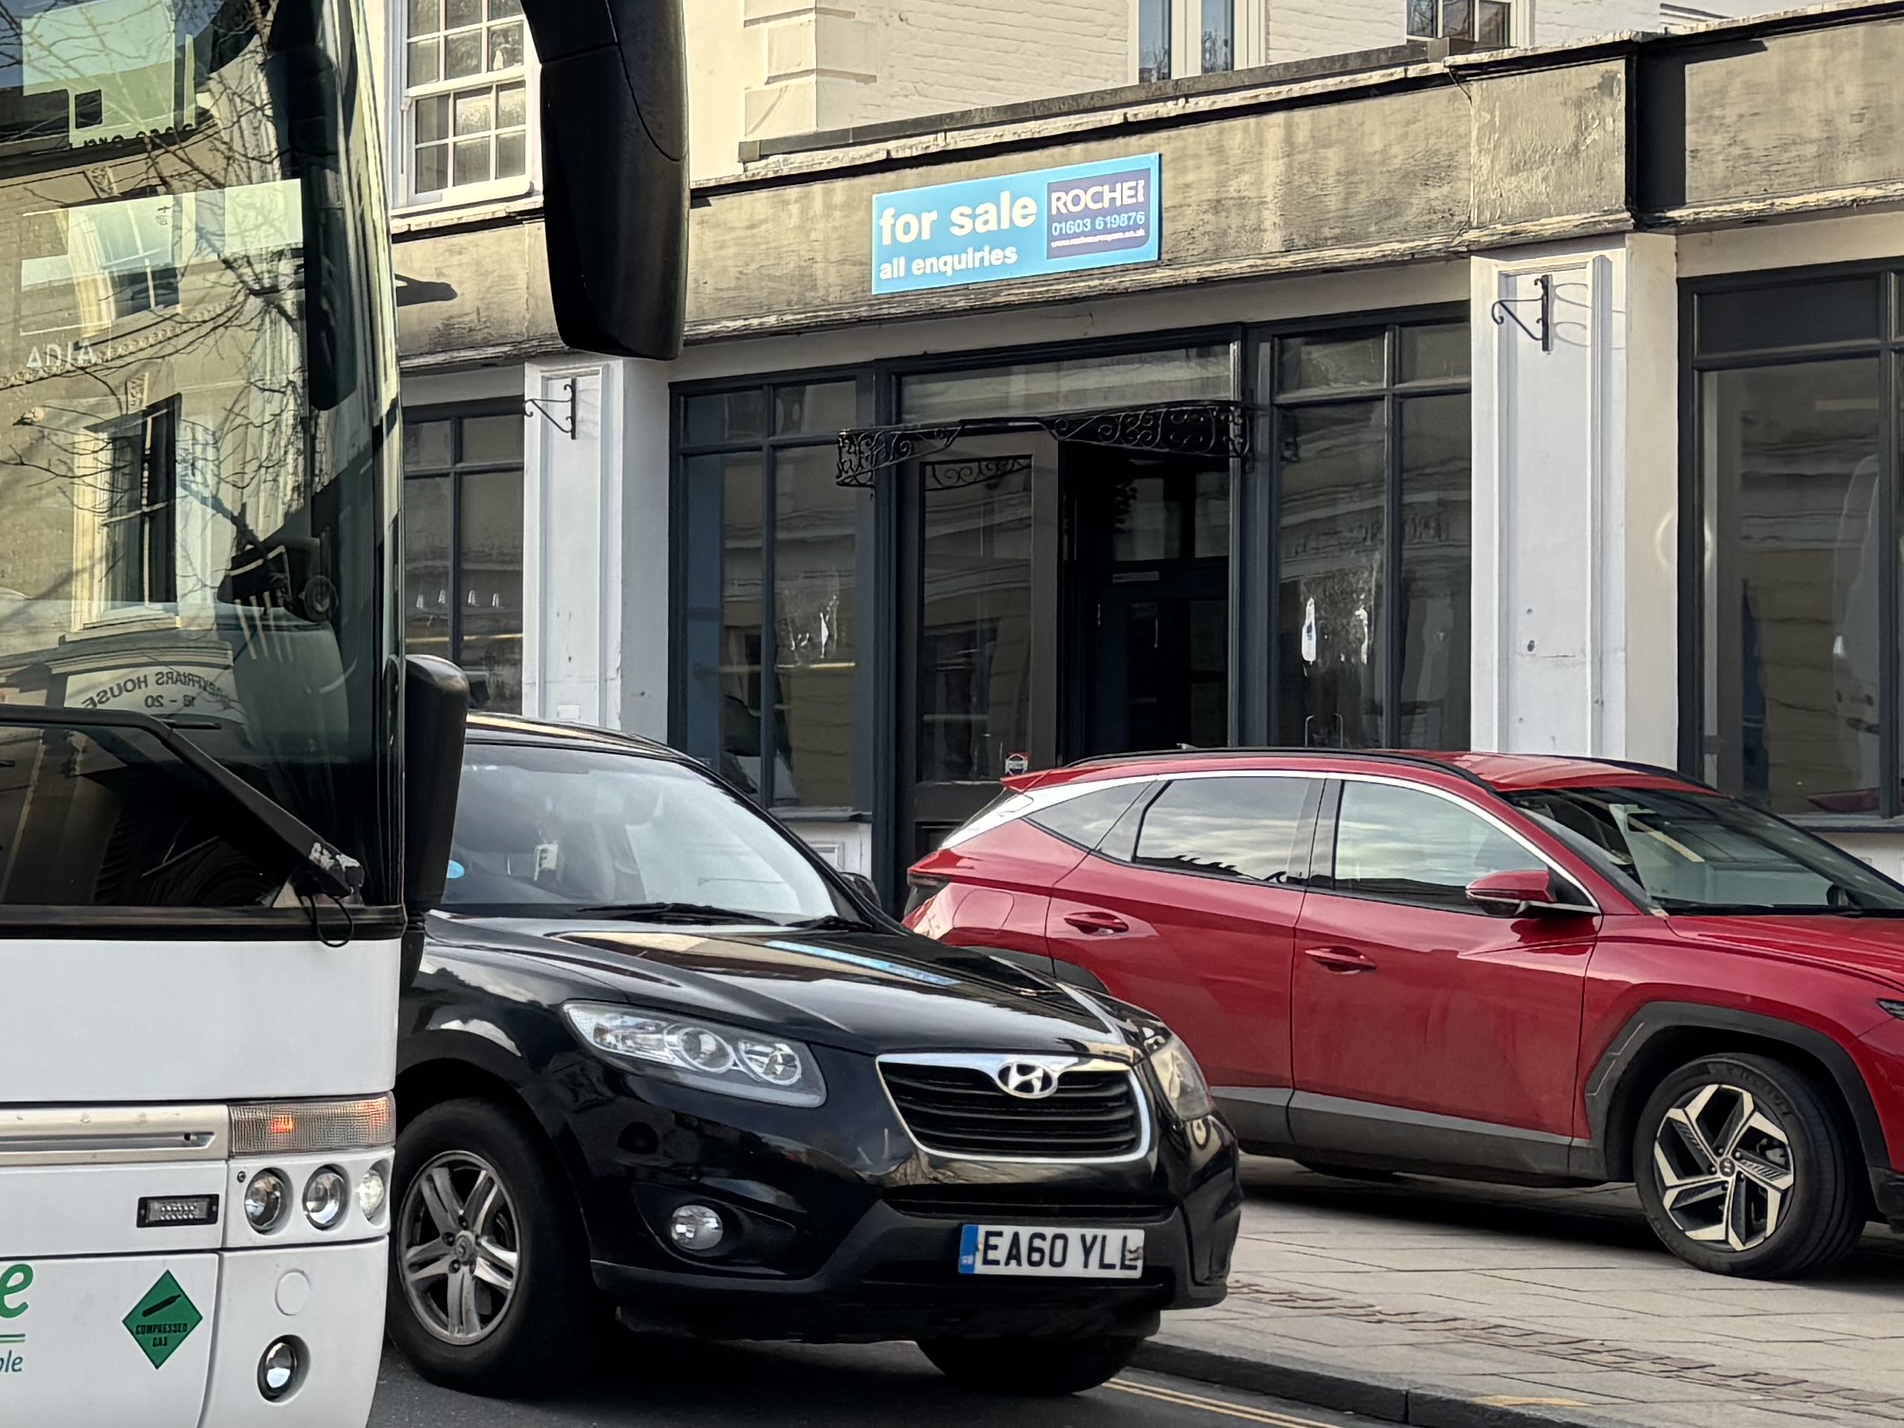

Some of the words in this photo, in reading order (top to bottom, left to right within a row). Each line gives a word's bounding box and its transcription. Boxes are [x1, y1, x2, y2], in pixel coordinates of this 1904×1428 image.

[1050, 180, 1139, 215] ROCHE
[879, 207, 938, 247] for
[949, 190, 1038, 238] sale
[1051, 218, 1092, 237] 01603
[1095, 211, 1146, 231] 619876
[879, 257, 906, 280] all
[911, 245, 1018, 276] enquiries
[982, 1230, 1069, 1268] EA60
[1080, 1233, 1139, 1271] YLL
[136, 1323, 188, 1335] COMPRESSED
[152, 1336, 168, 1348] GAS
